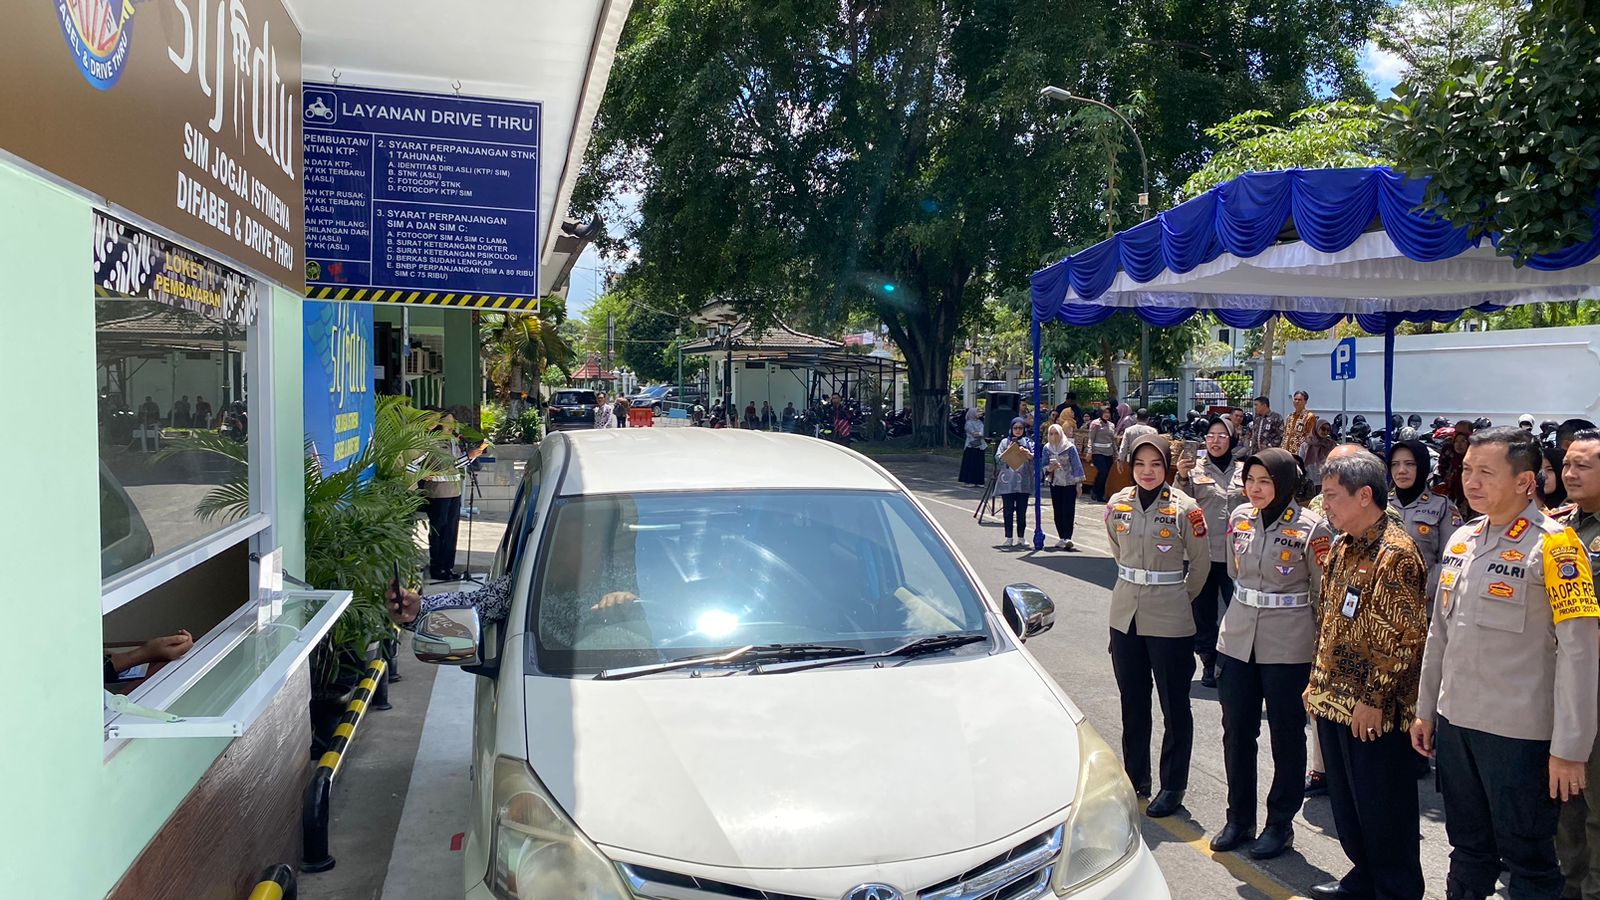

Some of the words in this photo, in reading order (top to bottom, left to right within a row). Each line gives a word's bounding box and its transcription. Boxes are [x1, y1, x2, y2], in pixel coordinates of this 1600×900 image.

[59, 0, 80, 57] ABEL
[82, 50, 88, 69] &
[90, 58, 113, 79] DRIVE
[112, 30, 128, 71] THRU
[342, 102, 426, 122] LAYANAN
[431, 110, 482, 127] DRIVE
[487, 115, 533, 132] THRU
[304, 134, 370, 146] PEMBUATAN/
[304, 144, 333, 154] NTIAN
[336, 147, 358, 156] KTP:
[378, 140, 386, 148] 2.
[388, 140, 428, 150] SYARAT
[430, 144, 508, 158] PERPANJANGAN
[510, 150, 536, 160] STNK
[311, 159, 333, 167] DATA
[396, 152, 446, 162] TAHUNAN:
[328, 168, 366, 177] TERBARU
[398, 162, 437, 171] IDENTITAS
[473, 168, 494, 176] (KTP/
[495, 170, 510, 178] SIM)
[420, 171, 442, 180] (ASLI)
[183, 122, 209, 172] SIM
[212, 146, 248, 202] JOGJA
[251, 176, 290, 232] ISTIMEWA
[312, 175, 335, 184] (ASLI)
[398, 178, 439, 186] FOTOCOPY
[336, 191, 366, 199] RUSAK:
[397, 186, 439, 194] FOTOCOPY
[441, 188, 458, 196] KTP/
[329, 199, 366, 207] TERBARU
[312, 206, 335, 214] (ASLI)
[176, 170, 231, 236] DIFABEL
[234, 209, 241, 241] &
[244, 215, 272, 260] DRIVE
[274, 234, 294, 272] THRU
[377, 209, 385, 217] 3.
[387, 210, 427, 220] SYARAT
[429, 212, 507, 225] PERPANJANGAN
[387, 220, 404, 228] SIM
[406, 221, 414, 229] A
[416, 222, 436, 230] DAN
[439, 223, 456, 232] SIM
[458, 224, 468, 233] C:
[319, 234, 342, 243] (ASLI)
[397, 232, 438, 240] FOTOCOPY
[327, 243, 350, 251] (ASLI)
[424, 241, 476, 251] KETERANGAN
[477, 244, 508, 253] DOKTER
[396, 255, 428, 263] BERKAS
[429, 257, 456, 265] SUDAH
[457, 258, 493, 267] LENGKAP
[424, 249, 476, 258] KETERANGAN
[477, 252, 518, 261] PSIKOLOGI
[166, 250, 204, 282] LOKET
[418, 264, 480, 274] PERPANJANGAN
[481, 267, 497, 276] (SIM
[427, 272, 448, 280] RIBU)
[156, 273, 221, 308] PEMBAYARAN
[1336, 344, 1350, 374] P
[1154, 516, 1177, 525] POLR
[1487, 563, 1526, 579] POLRI
[1559, 582, 1581, 599] OPS
[1560, 606, 1580, 616] PROGO
